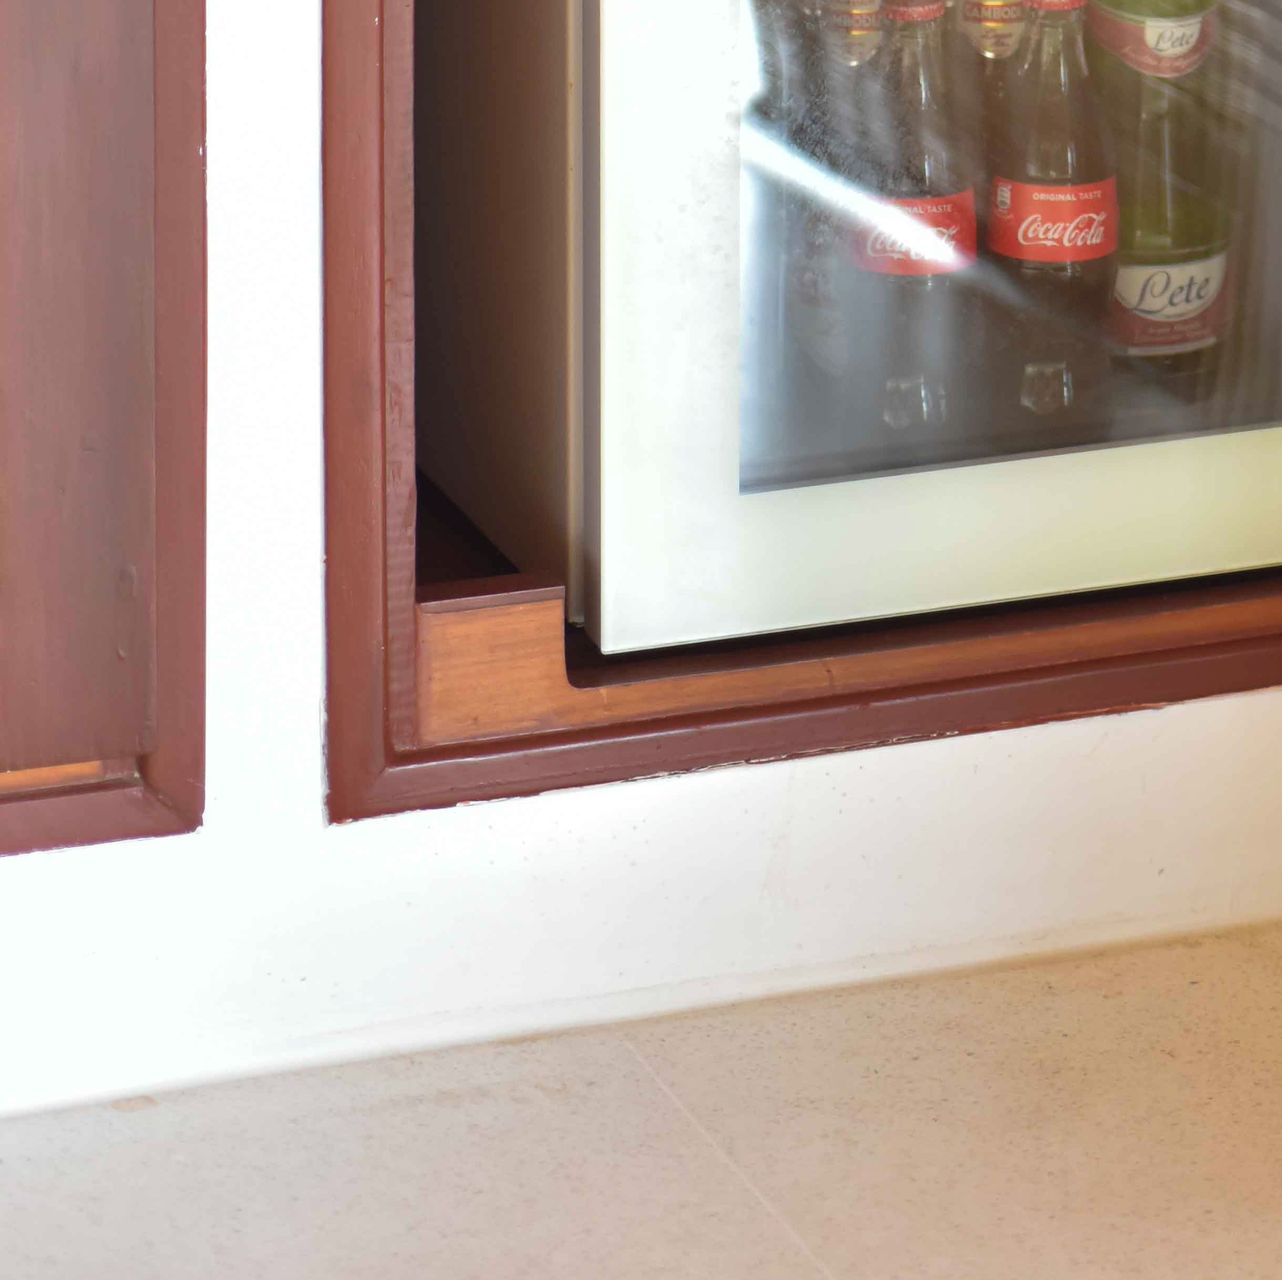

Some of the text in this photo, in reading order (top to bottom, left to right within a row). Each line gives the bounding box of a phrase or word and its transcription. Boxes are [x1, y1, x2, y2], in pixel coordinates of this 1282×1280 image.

[1032, 190, 1103, 201] ORIGINAL TASTE
[1017, 211, 1107, 247] Coca-Cola
[1133, 270, 1211, 315] Lete
